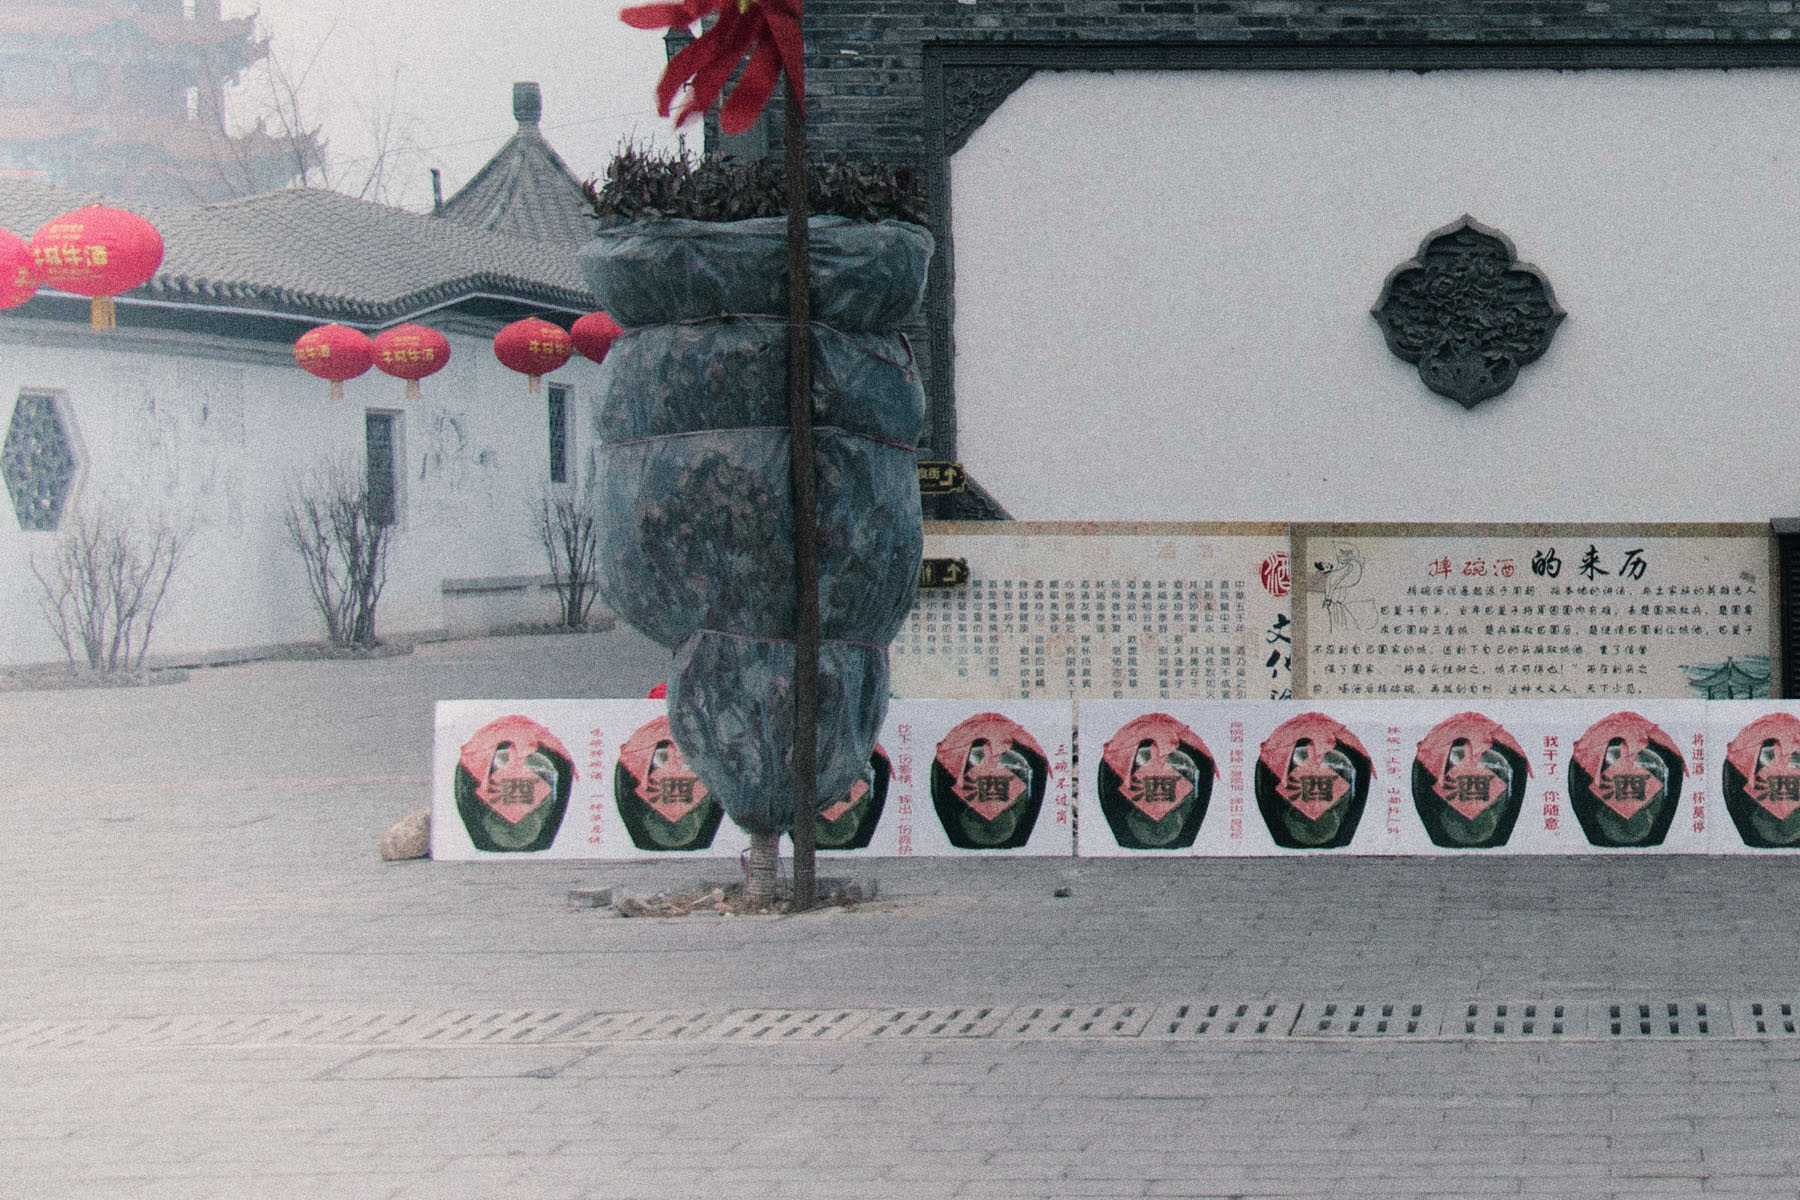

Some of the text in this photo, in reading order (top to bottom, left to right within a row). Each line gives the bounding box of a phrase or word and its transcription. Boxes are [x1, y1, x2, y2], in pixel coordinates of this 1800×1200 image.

[1428, 545, 1648, 582] 摔碗酒的来历
[1052, 743, 1070, 825] 三碗不过岗
